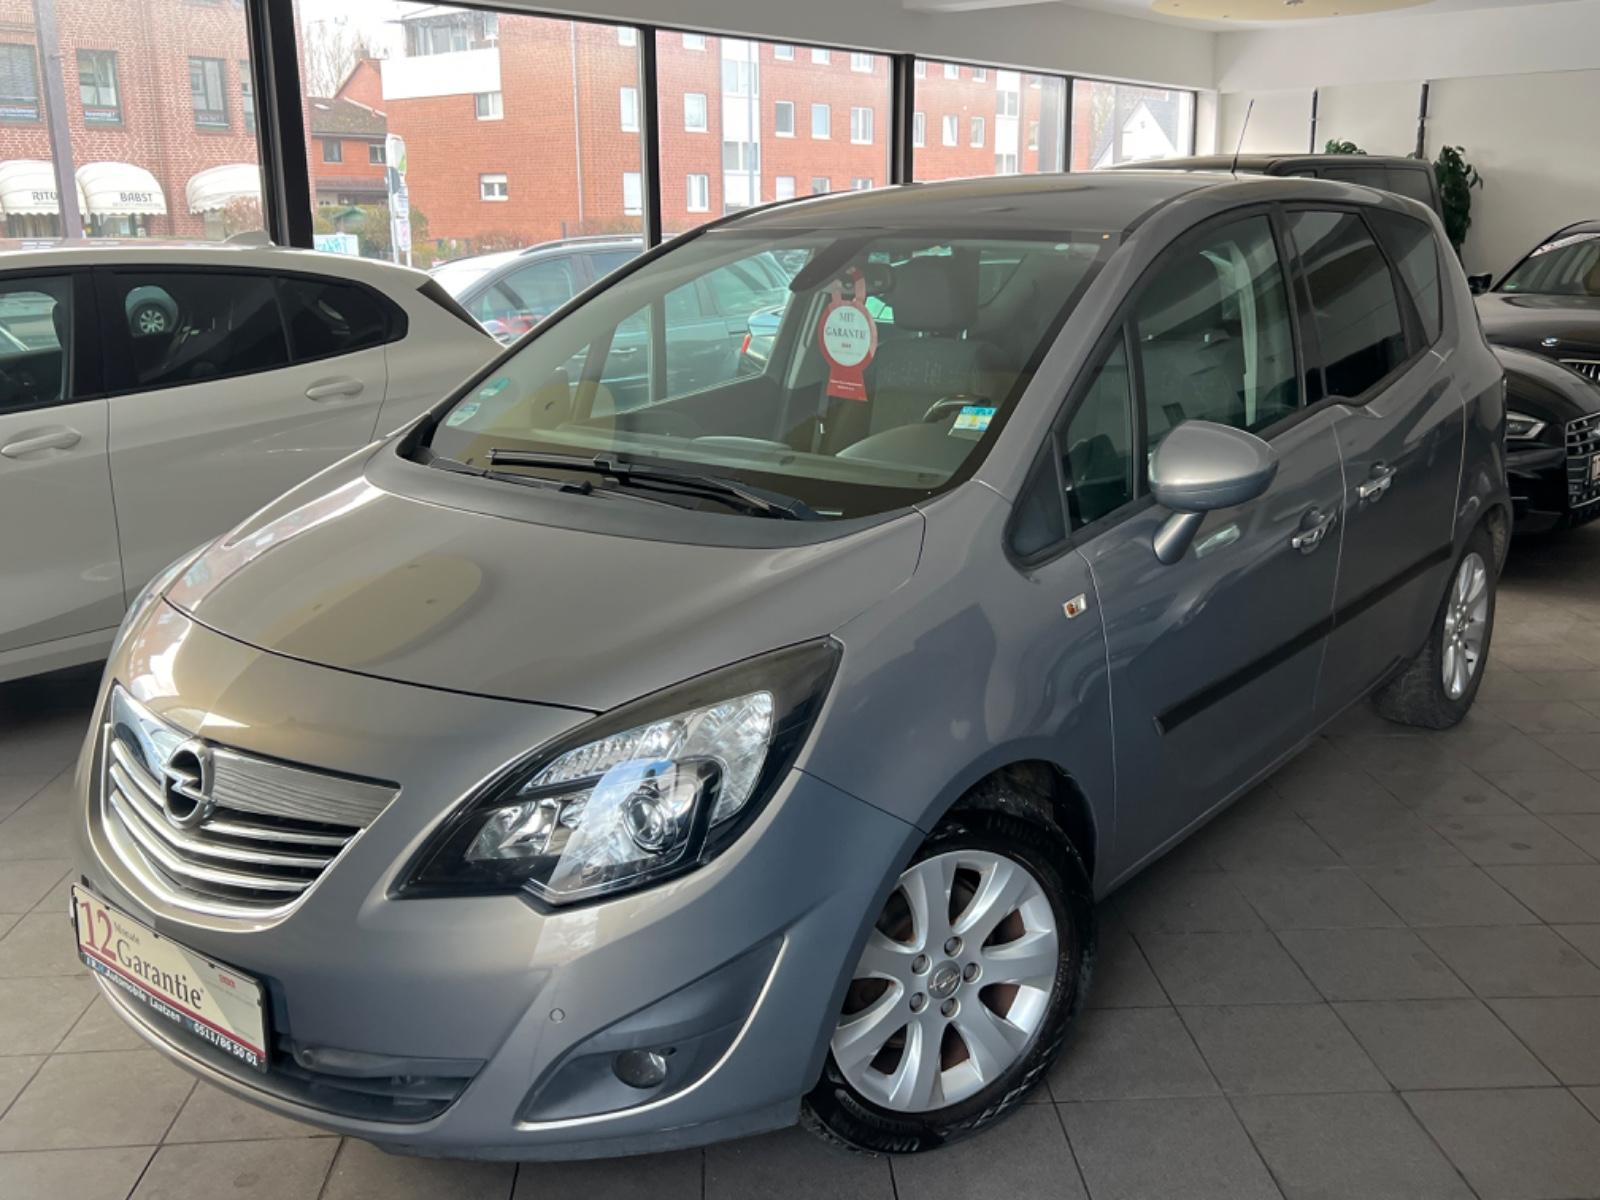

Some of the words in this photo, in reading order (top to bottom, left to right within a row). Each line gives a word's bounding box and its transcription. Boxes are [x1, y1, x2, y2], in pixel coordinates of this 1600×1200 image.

[120, 192, 152, 202] BABST
[839, 311, 856, 323] MIT
[80, 902, 117, 961] 12
